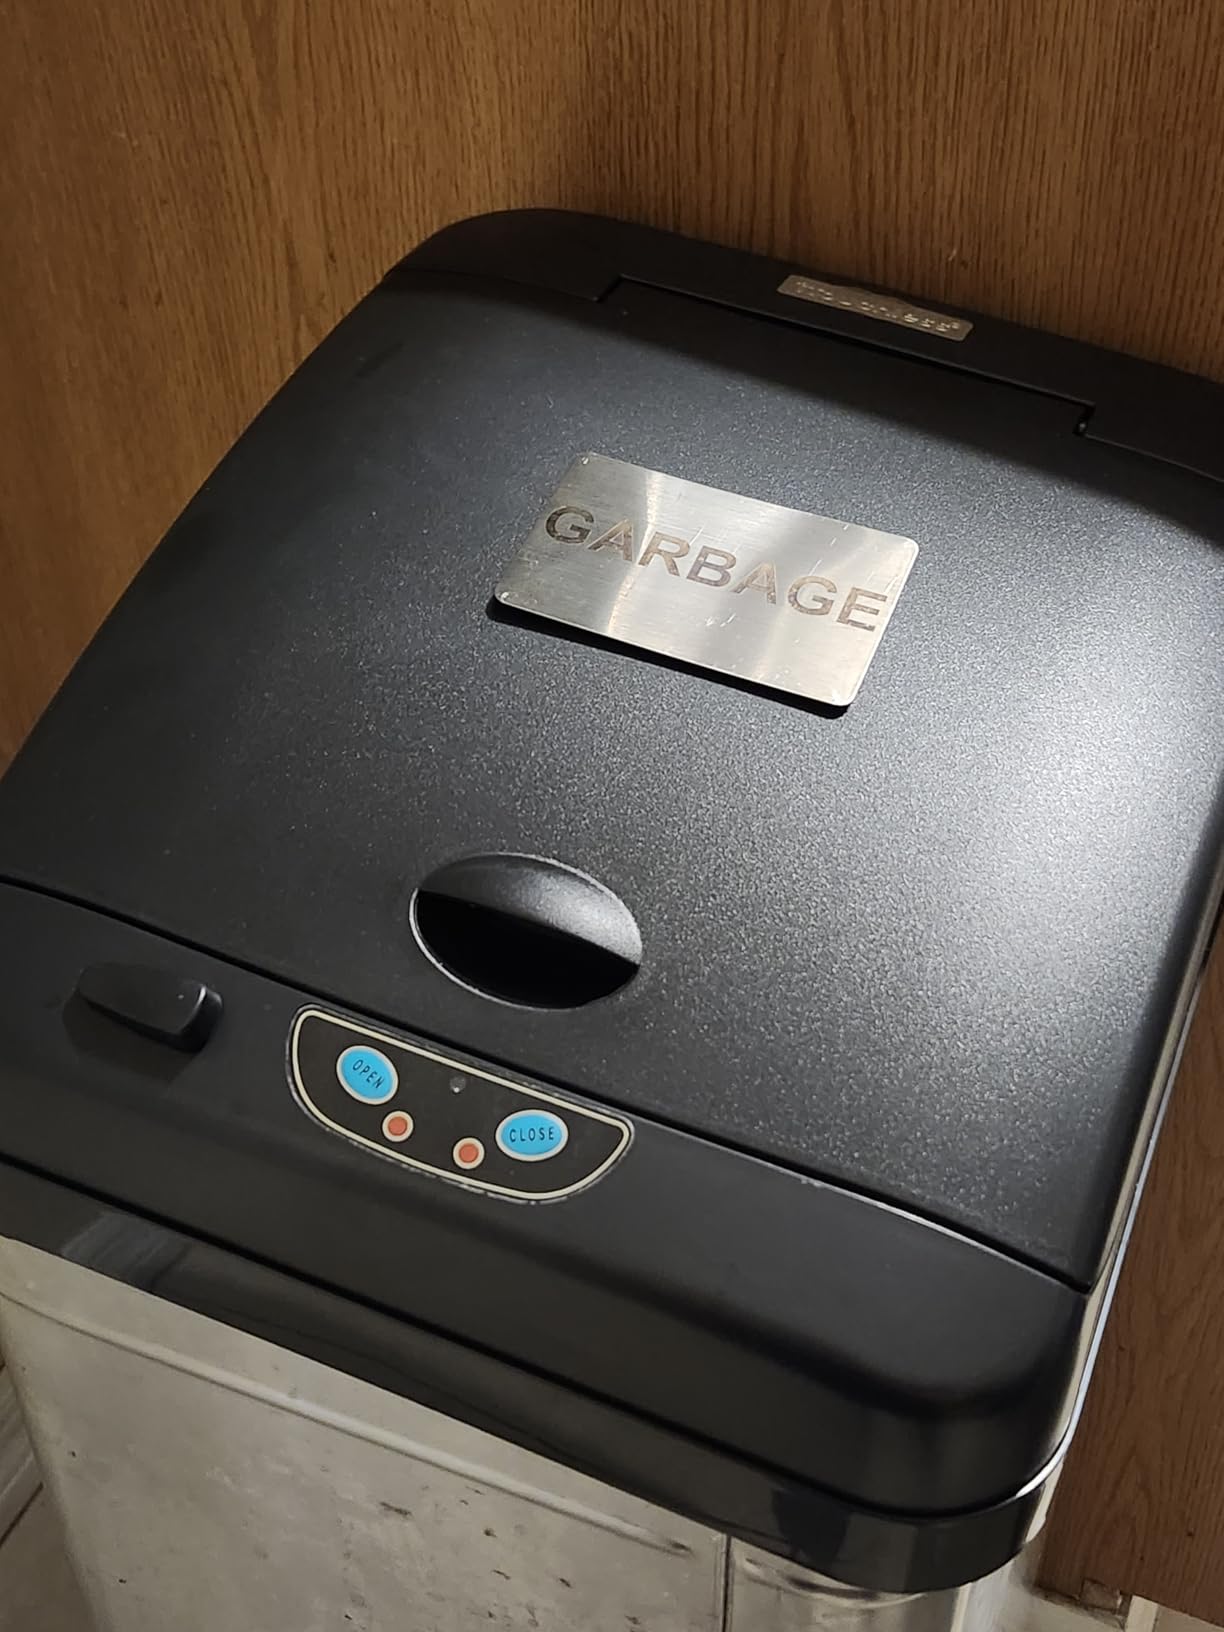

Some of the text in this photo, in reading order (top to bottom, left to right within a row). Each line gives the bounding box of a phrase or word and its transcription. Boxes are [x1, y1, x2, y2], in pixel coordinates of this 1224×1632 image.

[545, 505, 888, 631] GARBAGE
[352, 1059, 384, 1089] OPEN
[509, 1126, 554, 1142] CLOSE
